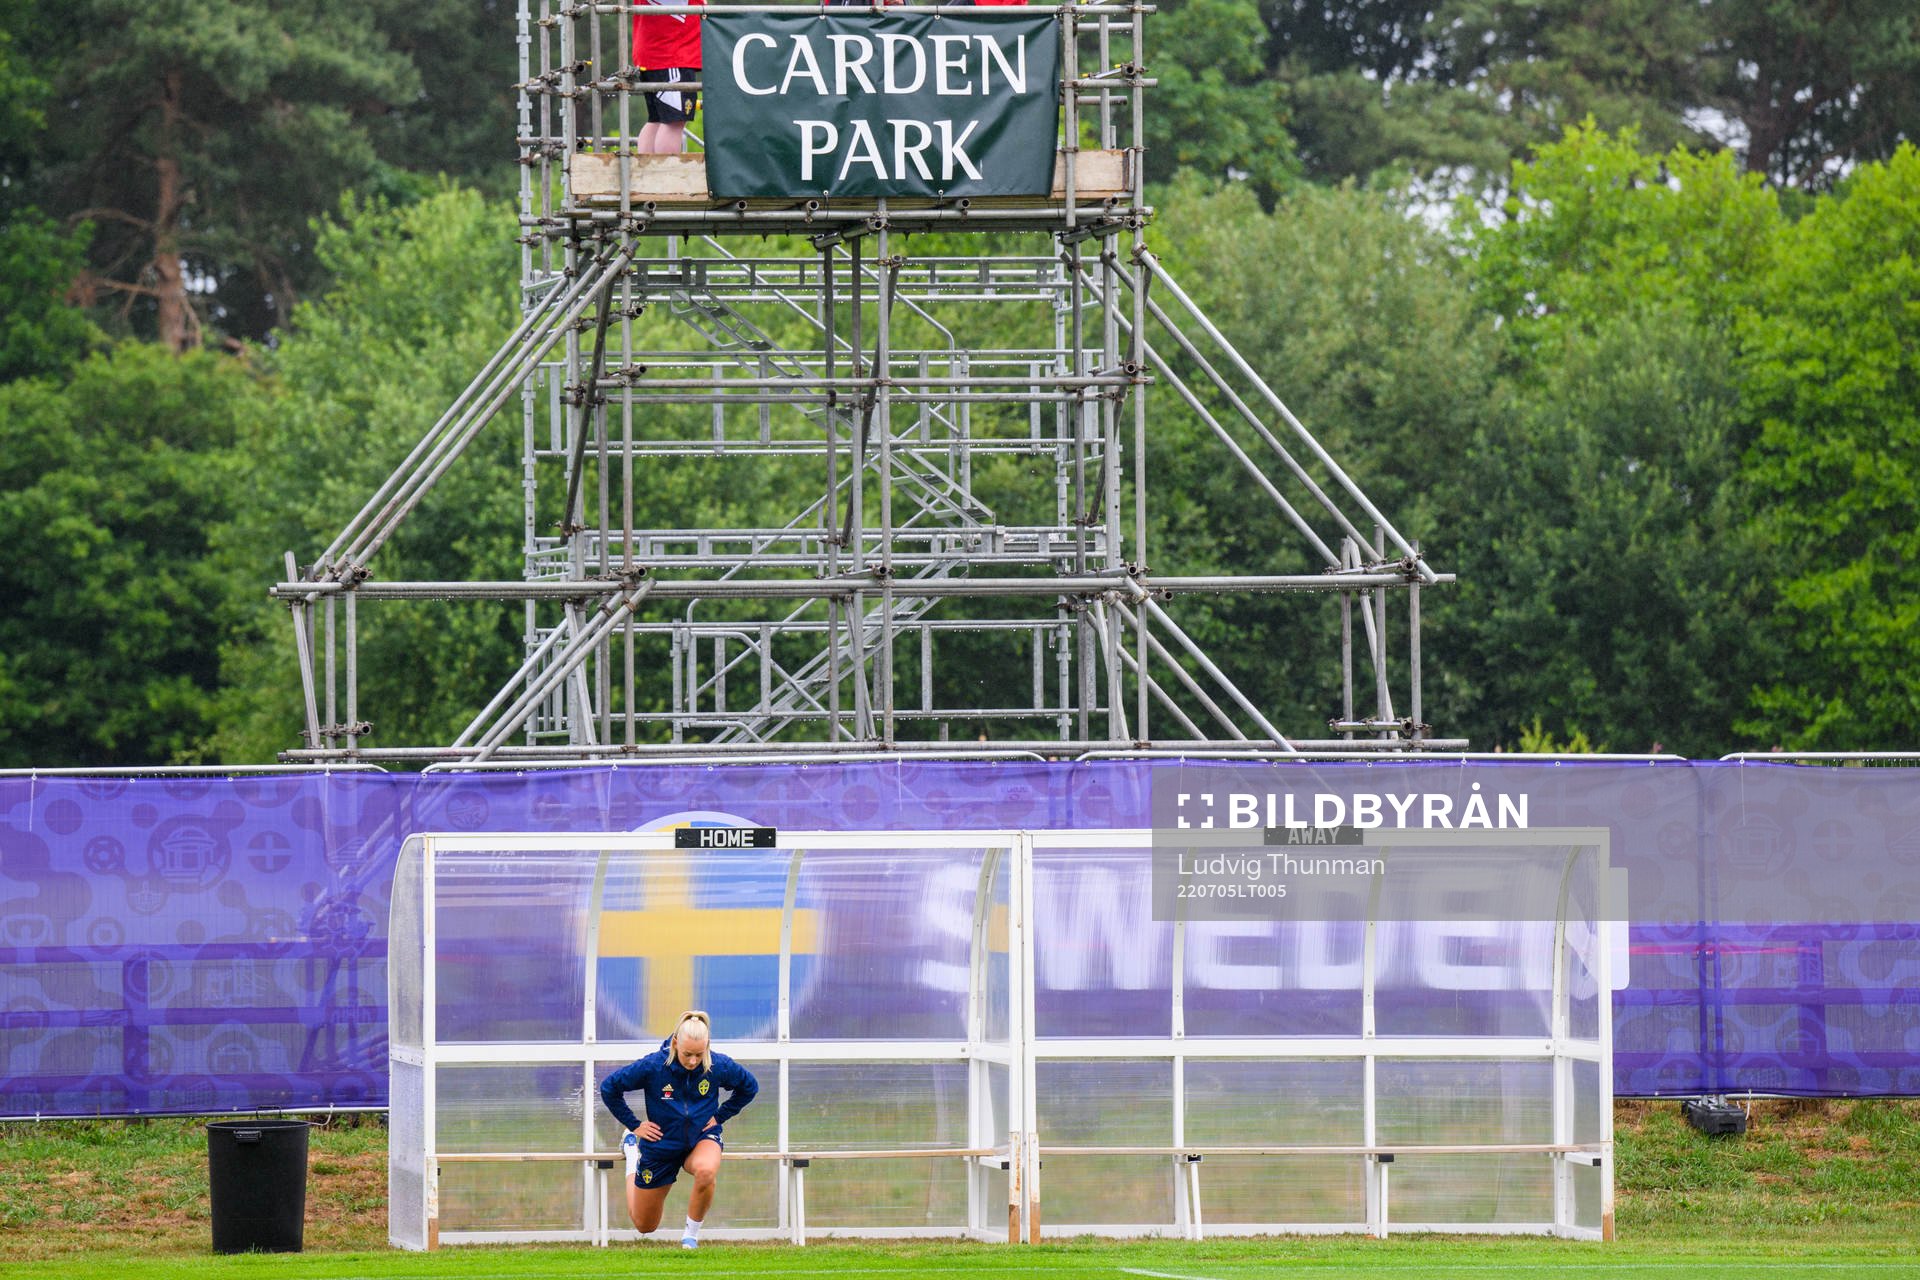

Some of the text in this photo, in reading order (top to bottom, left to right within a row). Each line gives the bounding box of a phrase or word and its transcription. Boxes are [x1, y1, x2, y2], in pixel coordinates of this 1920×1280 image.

[731, 33, 1026, 95] CARDEN
[793, 119, 983, 181] PARK
[700, 829, 754, 847] HOME
[1287, 827, 1340, 844] AWAY
